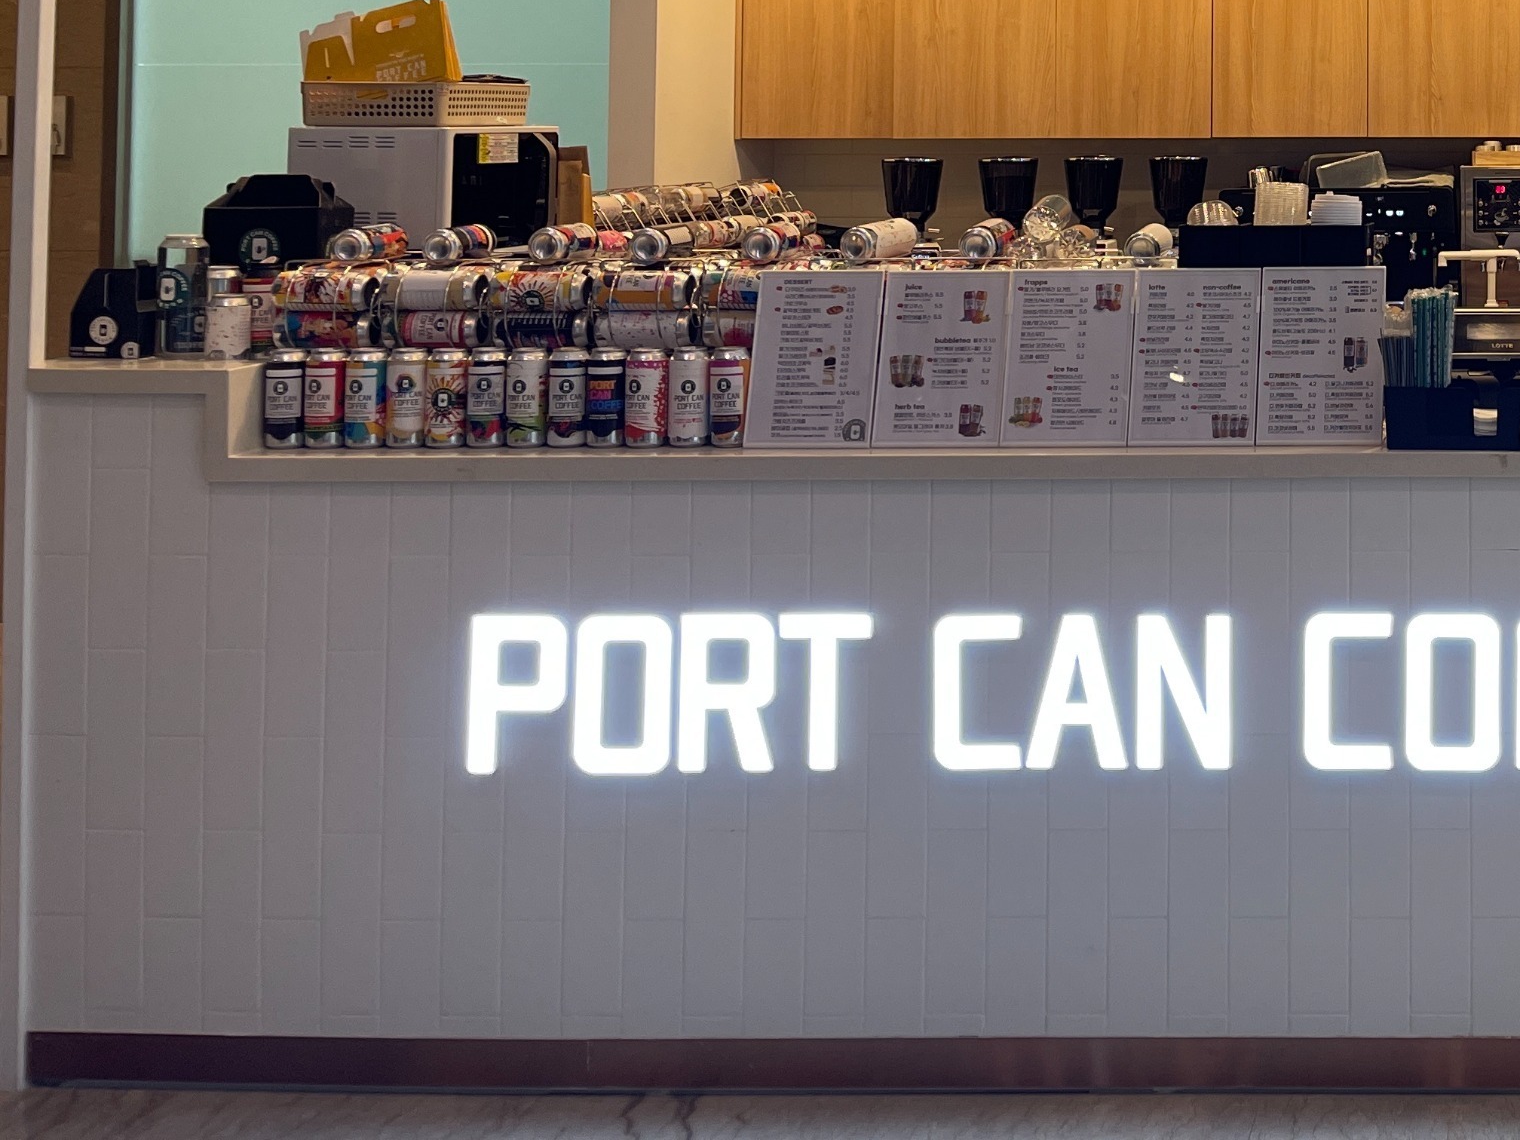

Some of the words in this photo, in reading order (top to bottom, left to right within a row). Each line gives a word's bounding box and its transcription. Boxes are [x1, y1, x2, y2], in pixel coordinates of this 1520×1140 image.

[590, 380, 616, 389] PORT
[465, 612, 875, 775] PORT
[930, 612, 1231, 775] CAN
